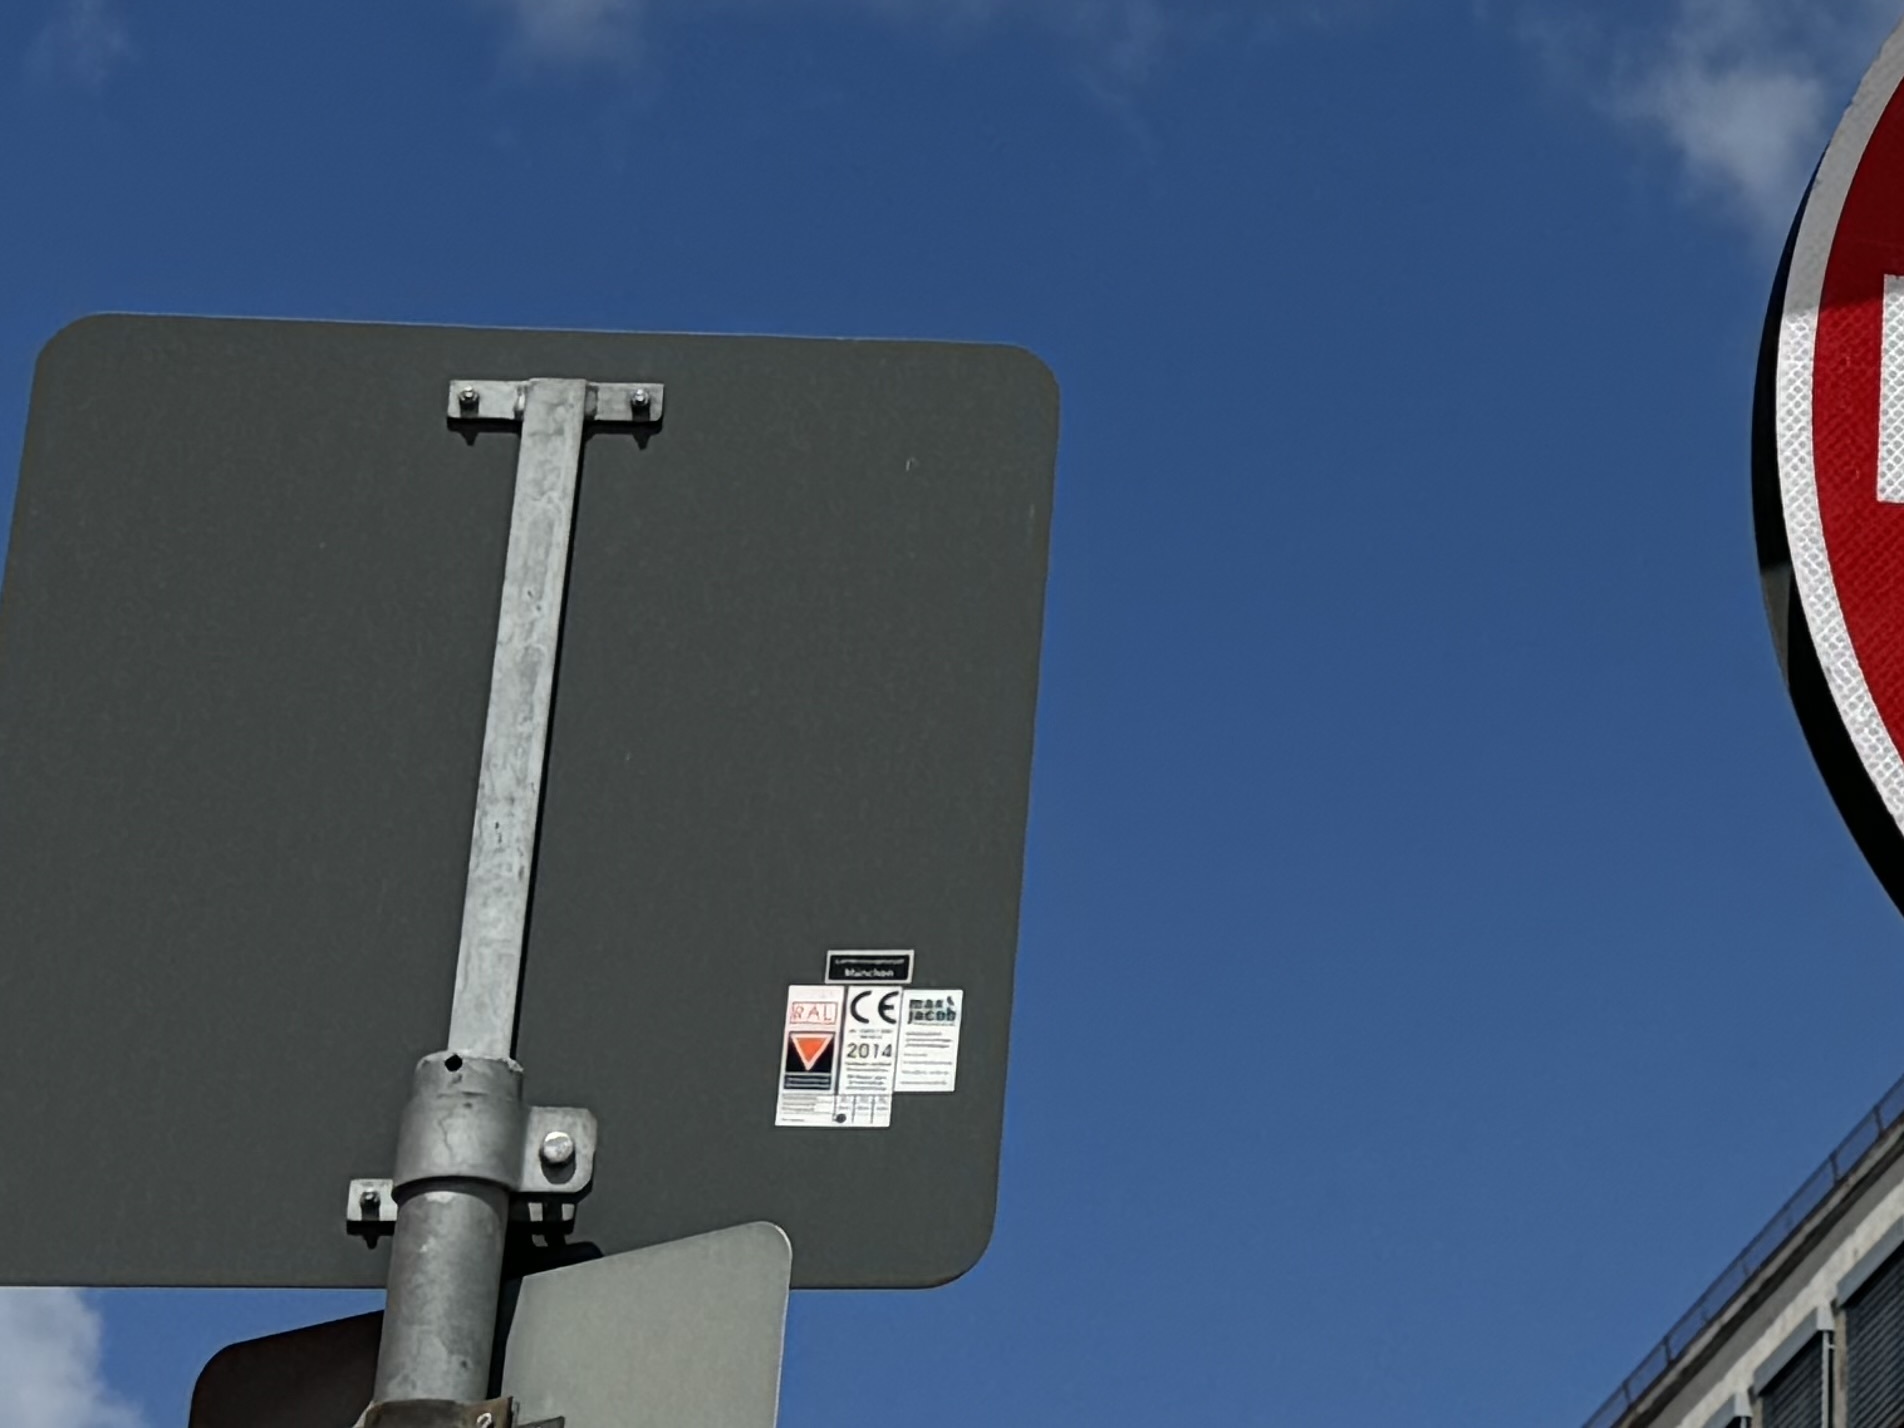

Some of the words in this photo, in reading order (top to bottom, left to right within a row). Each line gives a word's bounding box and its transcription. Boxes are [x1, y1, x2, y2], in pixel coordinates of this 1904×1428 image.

[793, 1005, 832, 1021] RAL
[850, 990, 900, 1024] CE
[907, 1007, 957, 1025] jacob
[846, 1043, 893, 1059] 2014
